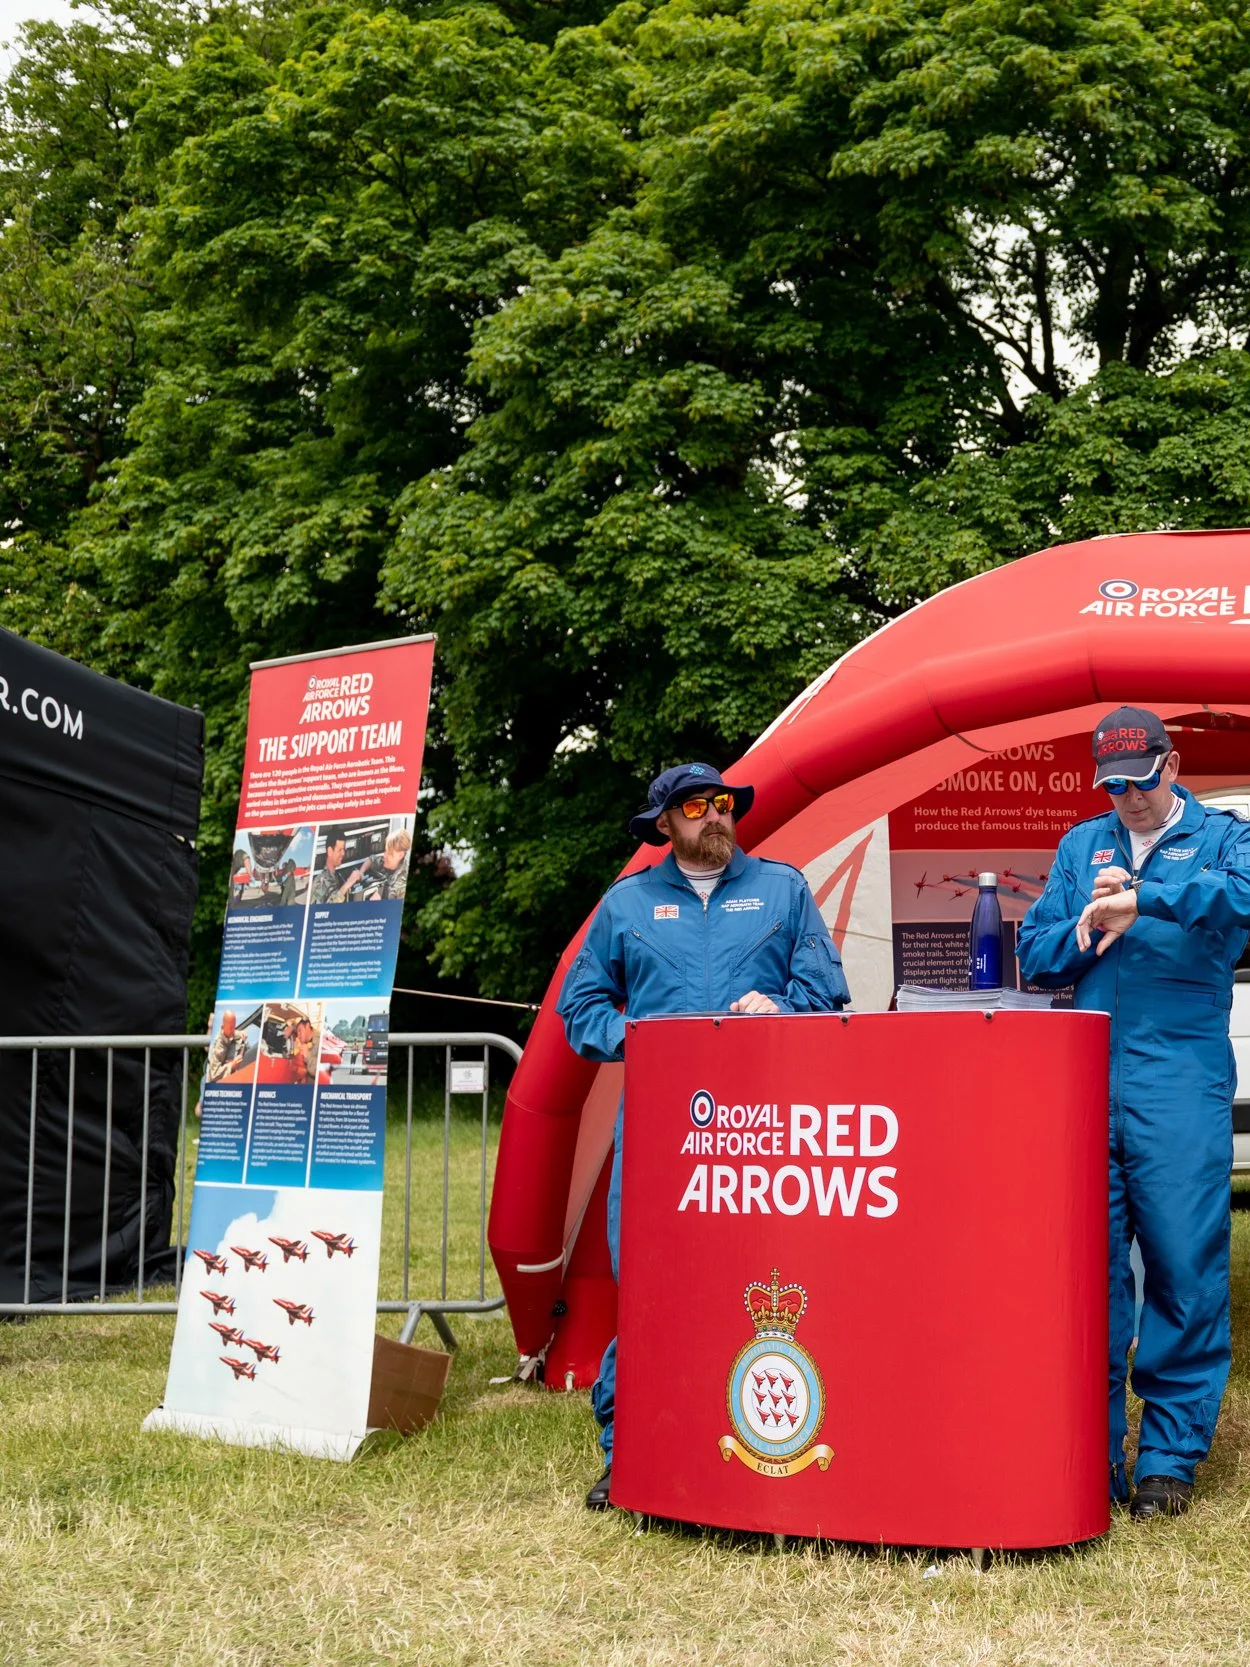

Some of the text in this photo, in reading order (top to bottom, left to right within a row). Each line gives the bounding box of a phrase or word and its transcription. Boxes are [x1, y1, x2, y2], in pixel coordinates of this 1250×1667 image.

[1141, 586, 1236, 601] ROYAL
[1079, 600, 1236, 617] AIR FORCE
[316, 676, 340, 690] ROYAL
[340, 672, 374, 696] RED
[303, 688, 340, 702] AIR FORCE
[299, 696, 370, 724] ARROWS
[259, 720, 402, 762] THE SUPPORT TEAM
[1118, 728, 1146, 739] RED
[987, 744, 1055, 760] ROWS
[1009, 771, 1044, 794] ON,
[1048, 772, 1082, 792] GO!
[914, 806, 938, 816] How
[940, 807, 958, 816] the
[960, 807, 982, 816] Red
[1026, 808, 1044, 818] dye
[1046, 808, 1078, 817] teams
[914, 821, 959, 832] produce
[962, 821, 979, 830] the
[982, 822, 1020, 830] famous
[1023, 822, 1049, 830] trails
[1050, 822, 1060, 830] in
[904, 968, 930, 976] displays
[904, 977, 938, 985] important
[939, 977, 957, 985] flight
[717, 1104, 784, 1128] ROYAL
[790, 1104, 899, 1158] RED
[680, 1131, 784, 1156] AIR FORCE
[677, 1164, 899, 1218] ARROWS
[756, 1463, 789, 1475] ECLAT
